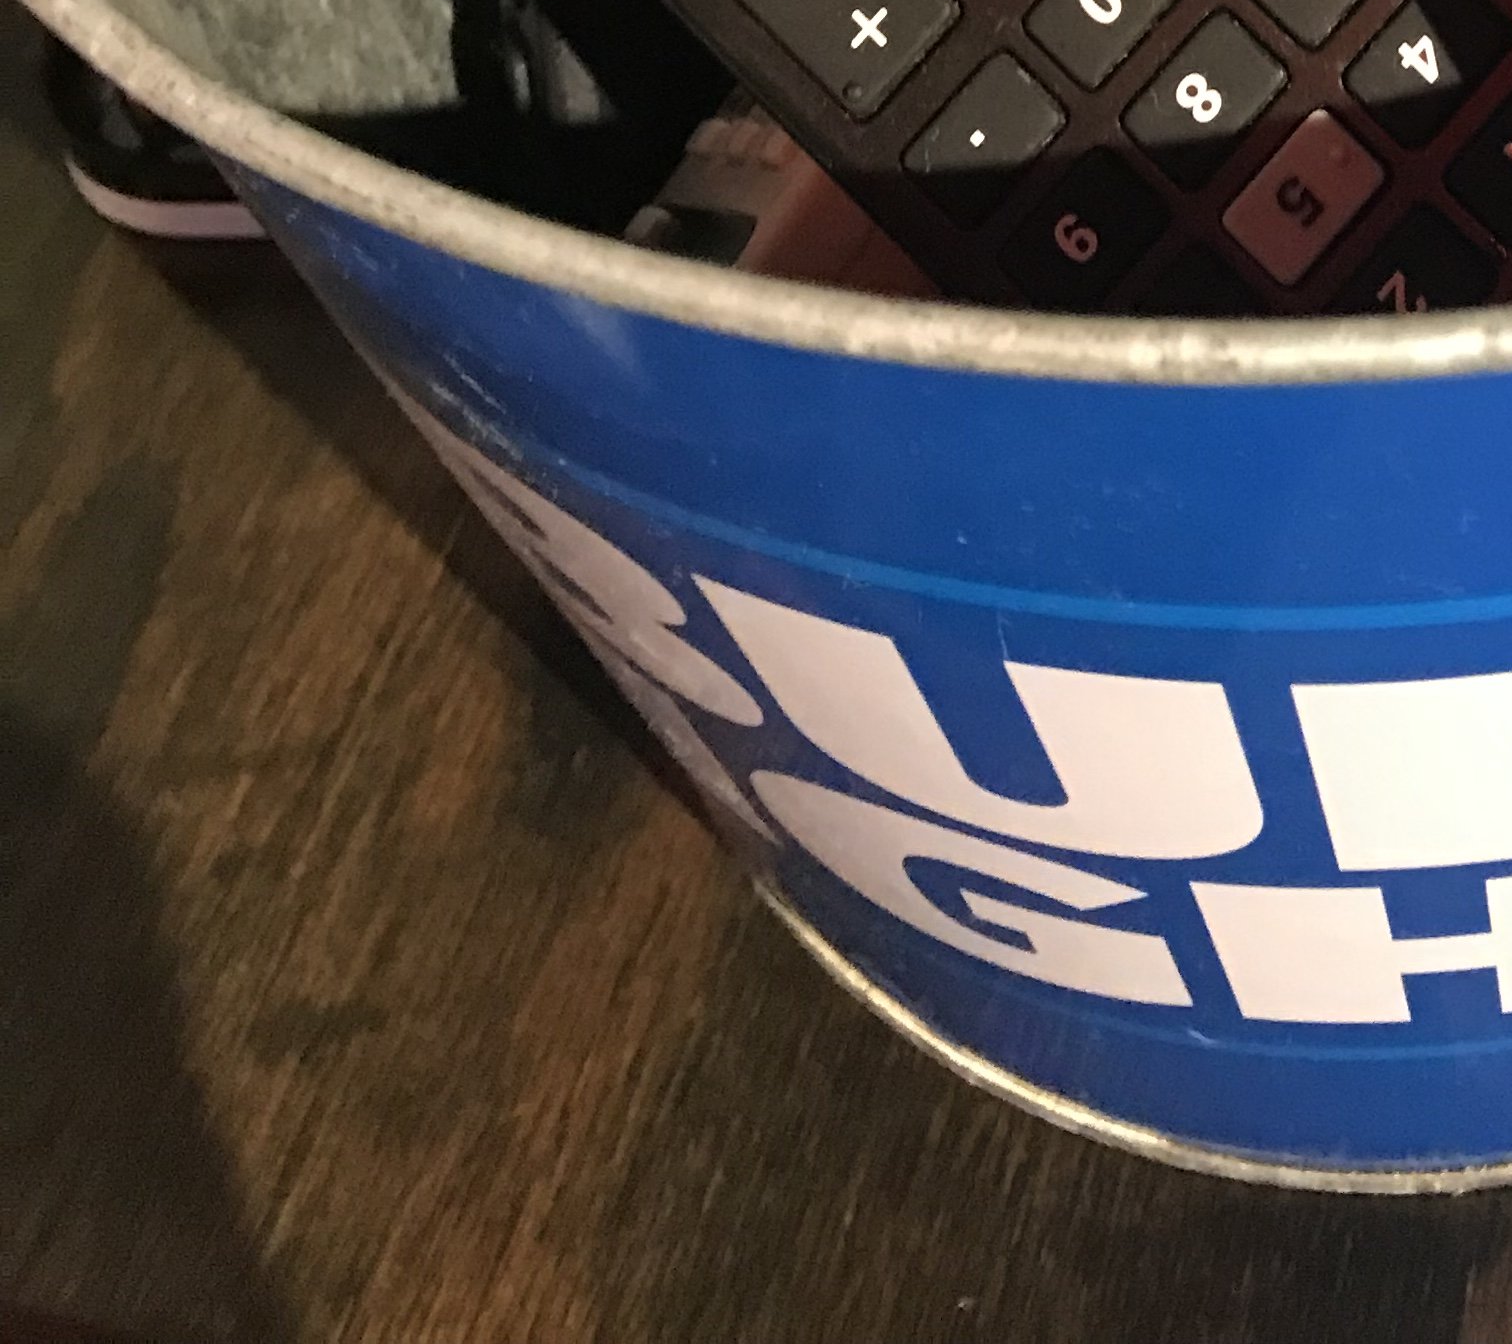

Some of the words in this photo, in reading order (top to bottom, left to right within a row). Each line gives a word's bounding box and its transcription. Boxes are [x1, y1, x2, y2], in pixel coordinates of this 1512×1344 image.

[1397, 34, 1440, 85] 4
[1175, 71, 1223, 124] 8
[1275, 175, 1326, 227] 5
[1053, 212, 1101, 264] 9
